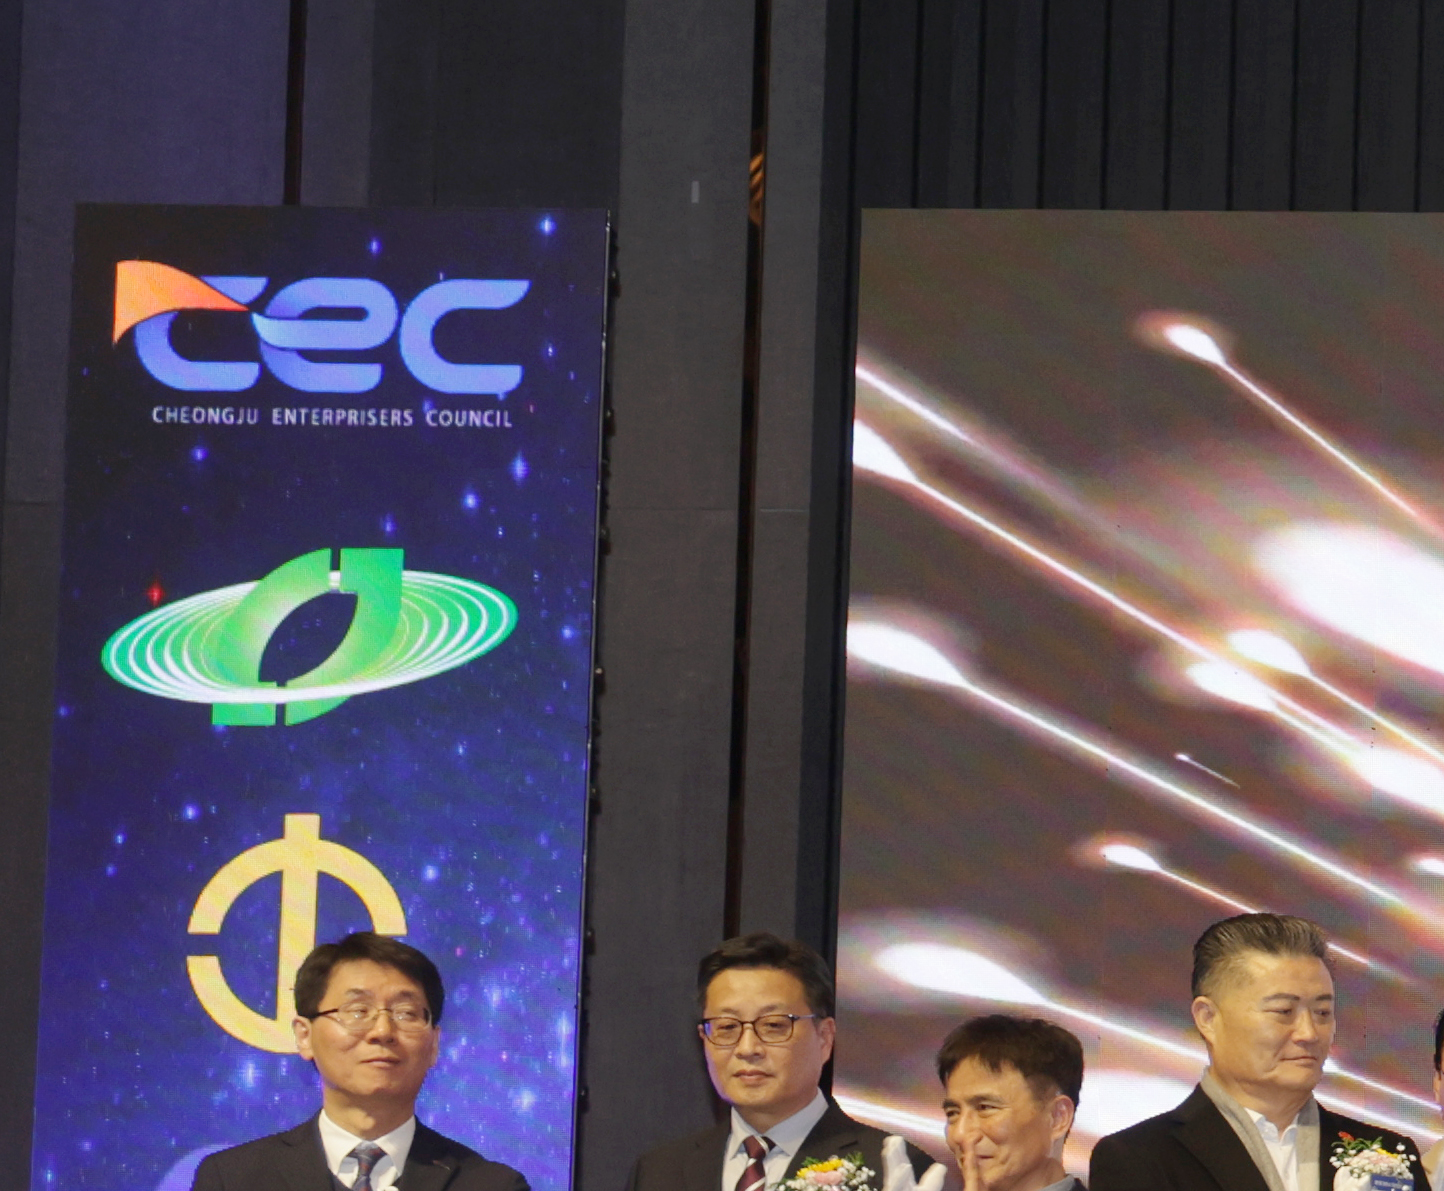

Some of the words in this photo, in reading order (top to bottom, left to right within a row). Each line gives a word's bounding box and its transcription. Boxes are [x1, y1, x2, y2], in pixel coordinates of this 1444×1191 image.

[153, 406, 259, 426] CHEONGJU
[272, 407, 414, 428] ENTERPRISERS
[426, 408, 513, 429] COUNCIL
